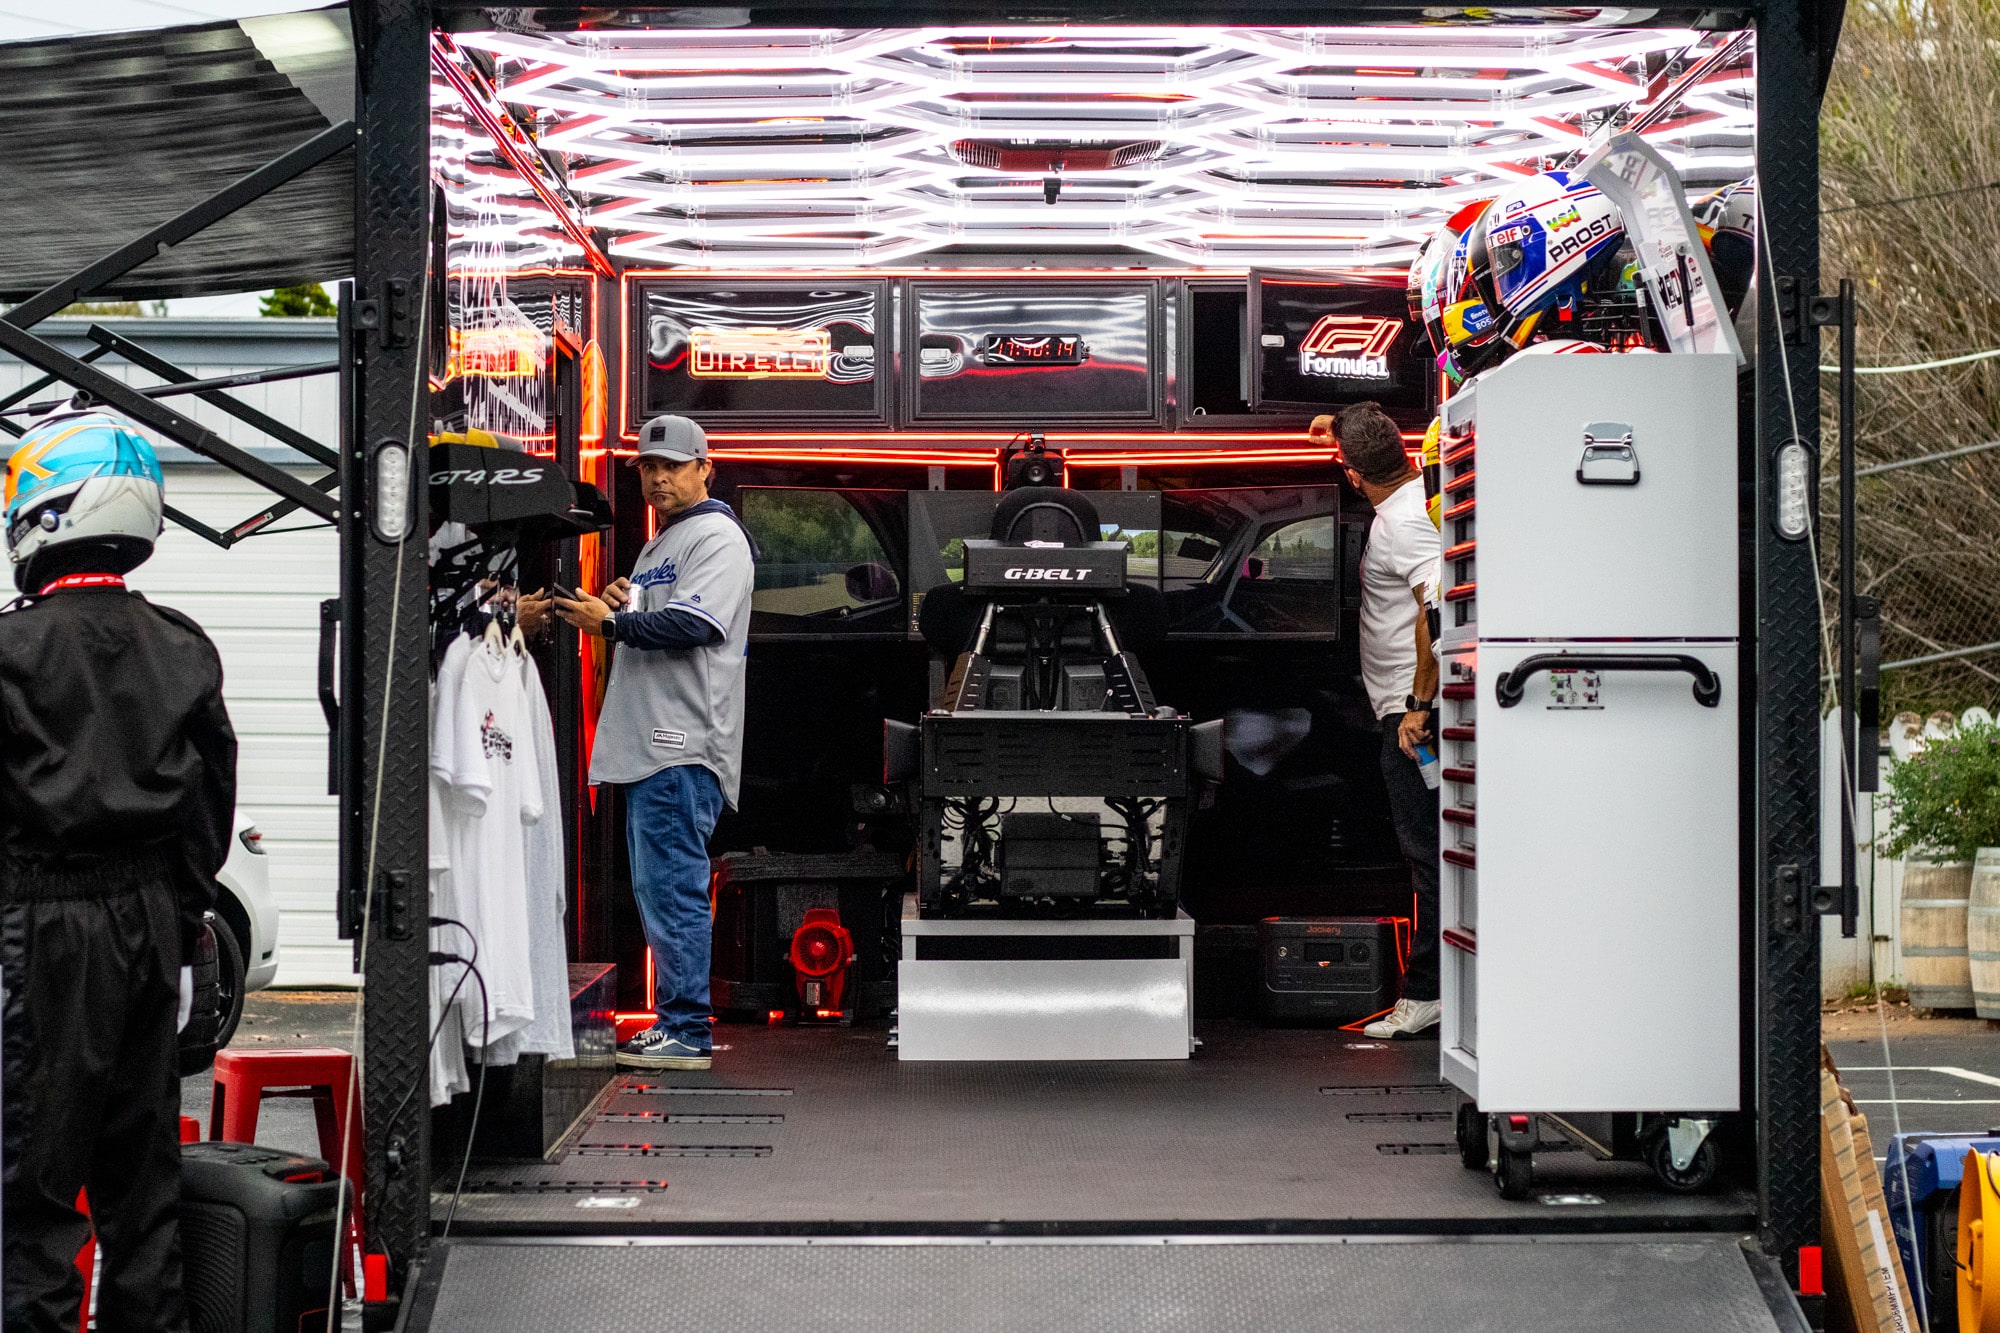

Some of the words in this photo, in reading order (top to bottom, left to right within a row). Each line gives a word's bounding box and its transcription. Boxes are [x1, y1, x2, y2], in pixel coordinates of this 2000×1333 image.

[1497, 229, 1517, 245] elf
[1548, 213, 1612, 263] PROST
[1475, 318, 1493, 331] BOS
[1302, 316, 1402, 356] F1
[1304, 351, 1388, 376] Formula1
[428, 469, 487, 485] GT4
[488, 468, 545, 485] RS
[631, 557, 676, 590] ngeles
[1004, 568, 1093, 581] G-BELT
[1307, 926, 1341, 936] Jackery
